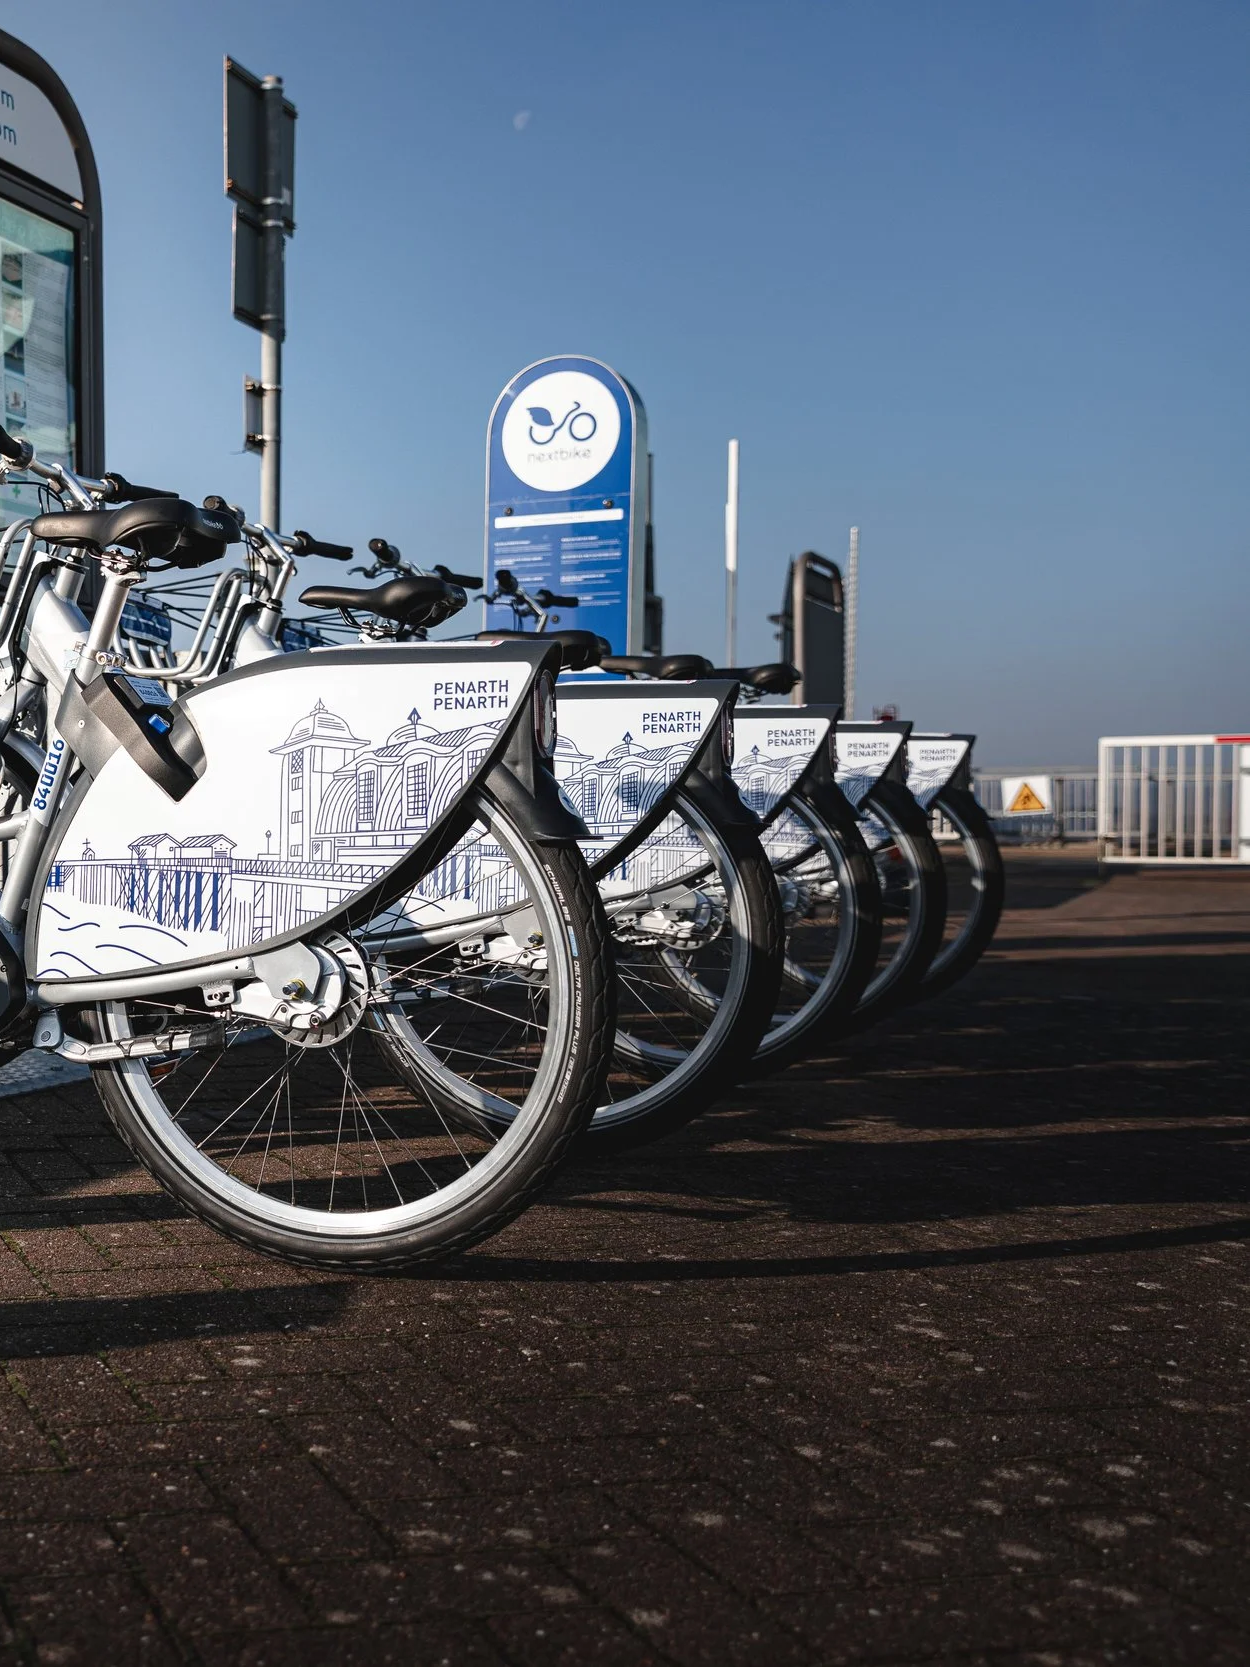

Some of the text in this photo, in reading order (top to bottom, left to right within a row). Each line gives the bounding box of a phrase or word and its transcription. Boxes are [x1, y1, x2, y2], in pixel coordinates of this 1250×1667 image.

[527, 446, 592, 464] nextbike
[433, 679, 509, 695] PENARTH
[433, 695, 508, 711] PENARTH
[642, 711, 701, 723] PENARTH
[642, 722, 701, 734] PENARTH
[767, 728, 816, 738] PENARTH
[767, 737, 816, 747] PENARTH
[847, 742, 889, 750] PENARTH
[847, 749, 889, 758] PENARTH
[33, 739, 65, 811] 840016
[543, 863, 571, 922] SCHWALBE
[570, 960, 582, 1056] DELTA CRUISER PLUS
